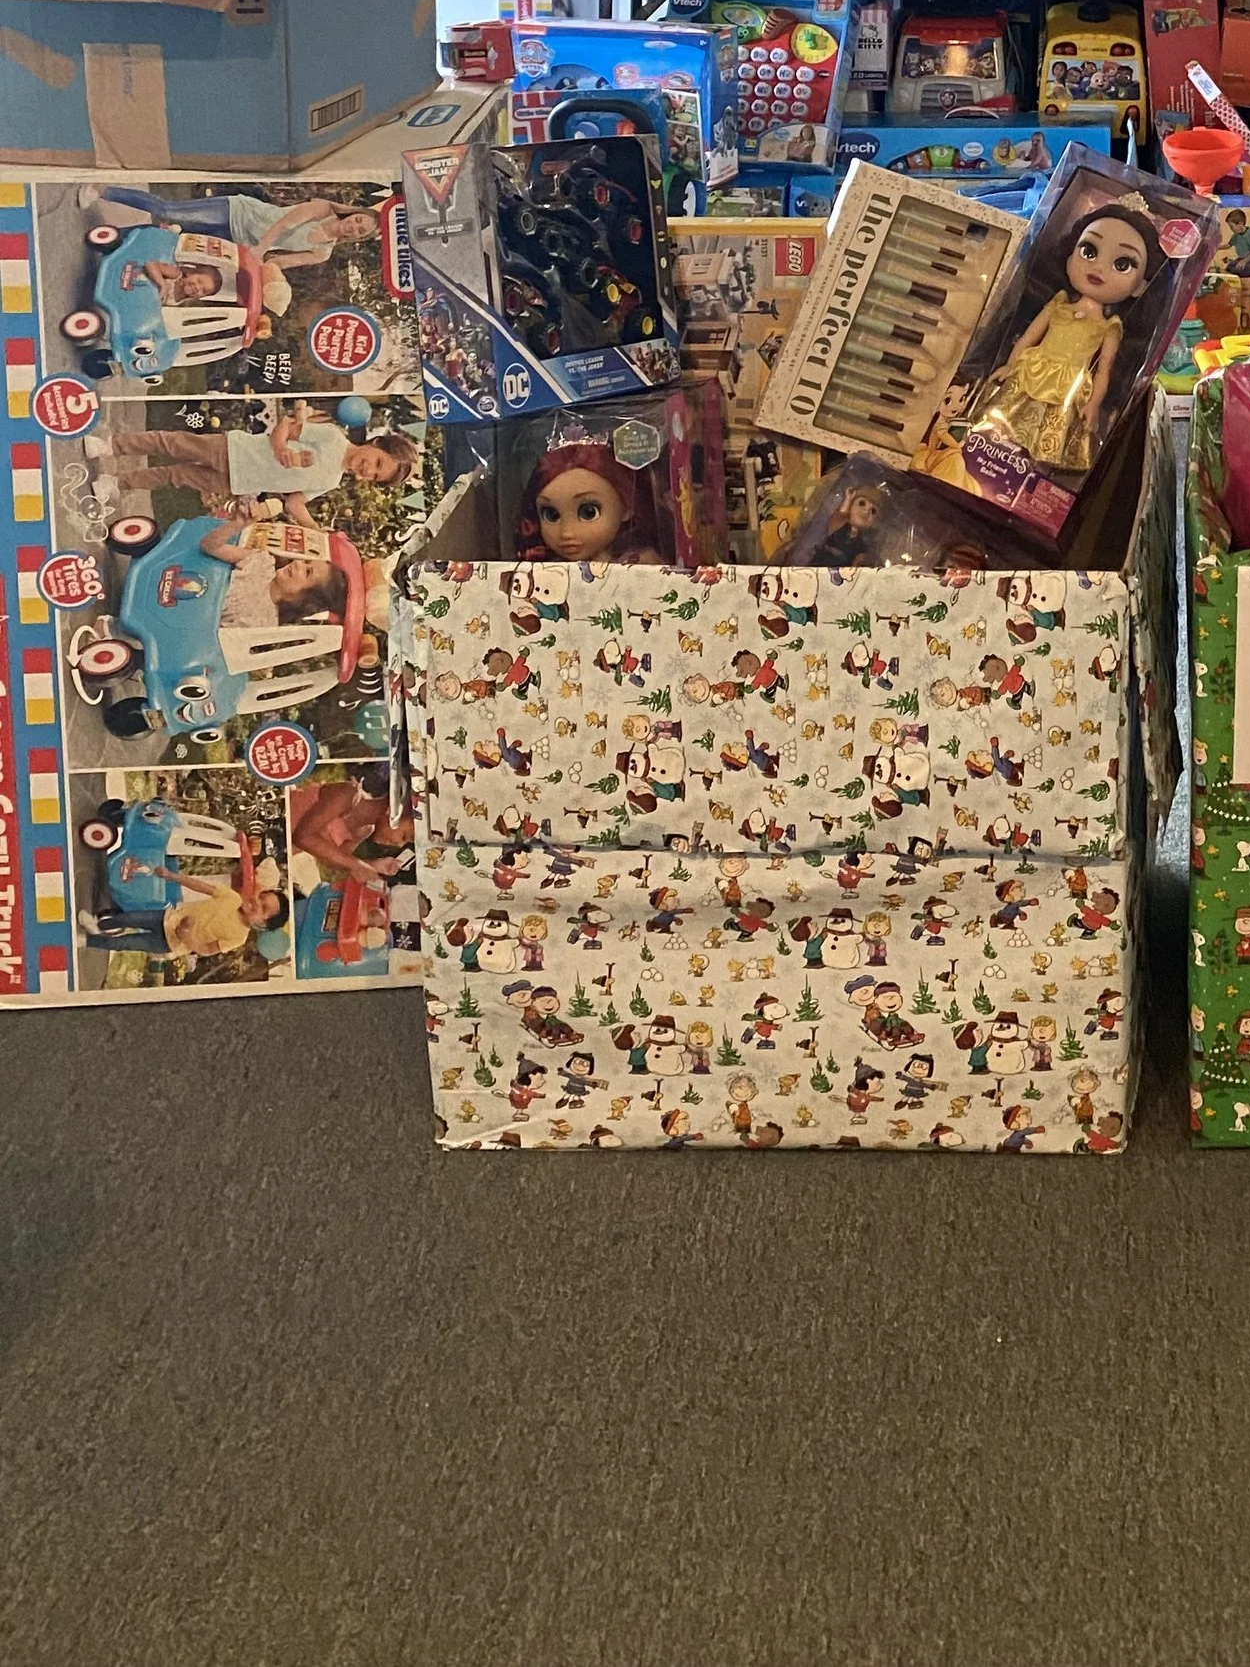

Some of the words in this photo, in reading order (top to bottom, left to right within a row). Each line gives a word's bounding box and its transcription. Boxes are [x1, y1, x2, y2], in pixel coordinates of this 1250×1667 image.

[415, 157, 460, 171] MONSTER
[428, 167, 449, 177] JAM
[855, 192, 893, 245] the
[787, 240, 804, 275] LEGO
[806, 247, 869, 369] perfect
[316, 325, 332, 354] Push
[328, 328, 344, 365] Parent
[343, 318, 360, 365] Powered
[355, 335, 368, 355] Kid
[263, 354, 277, 384] BEEP!
[277, 353, 292, 386] BEEP!
[42, 391, 58, 426] Included
[51, 384, 70, 430] Accessories
[66, 390, 100, 416] 5
[789, 377, 823, 416] 10
[966, 433, 1030, 474] PRINCESS
[987, 460, 1008, 474] Friend
[61, 561, 81, 597] Tires
[76, 555, 106, 600] 360°
